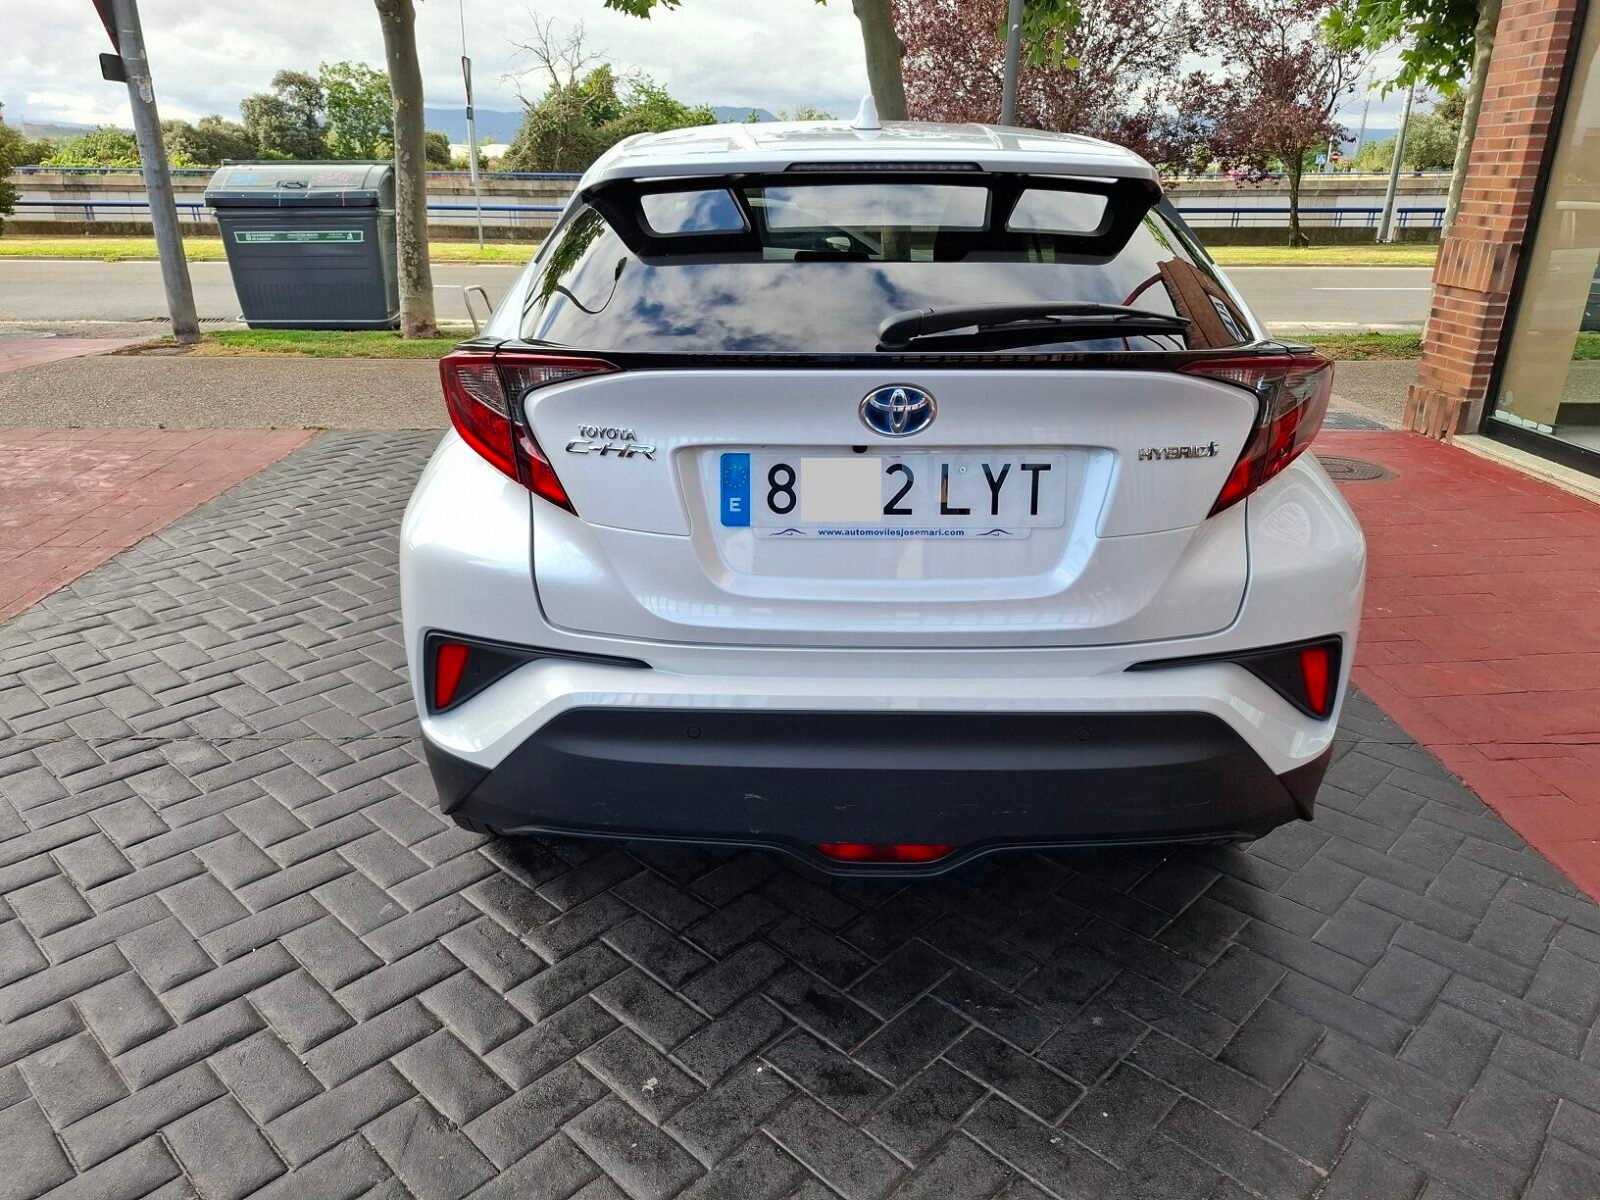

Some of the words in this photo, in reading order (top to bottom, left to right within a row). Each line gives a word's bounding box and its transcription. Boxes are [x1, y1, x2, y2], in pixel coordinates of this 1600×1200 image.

[578, 424, 637, 441] TOYOTA
[565, 439, 656, 461] C-HR
[767, 463, 914, 515] 82
[940, 463, 1051, 515] LYT
[729, 497, 741, 512] E
[818, 528, 965, 537] www.automovilesjosemari.com
